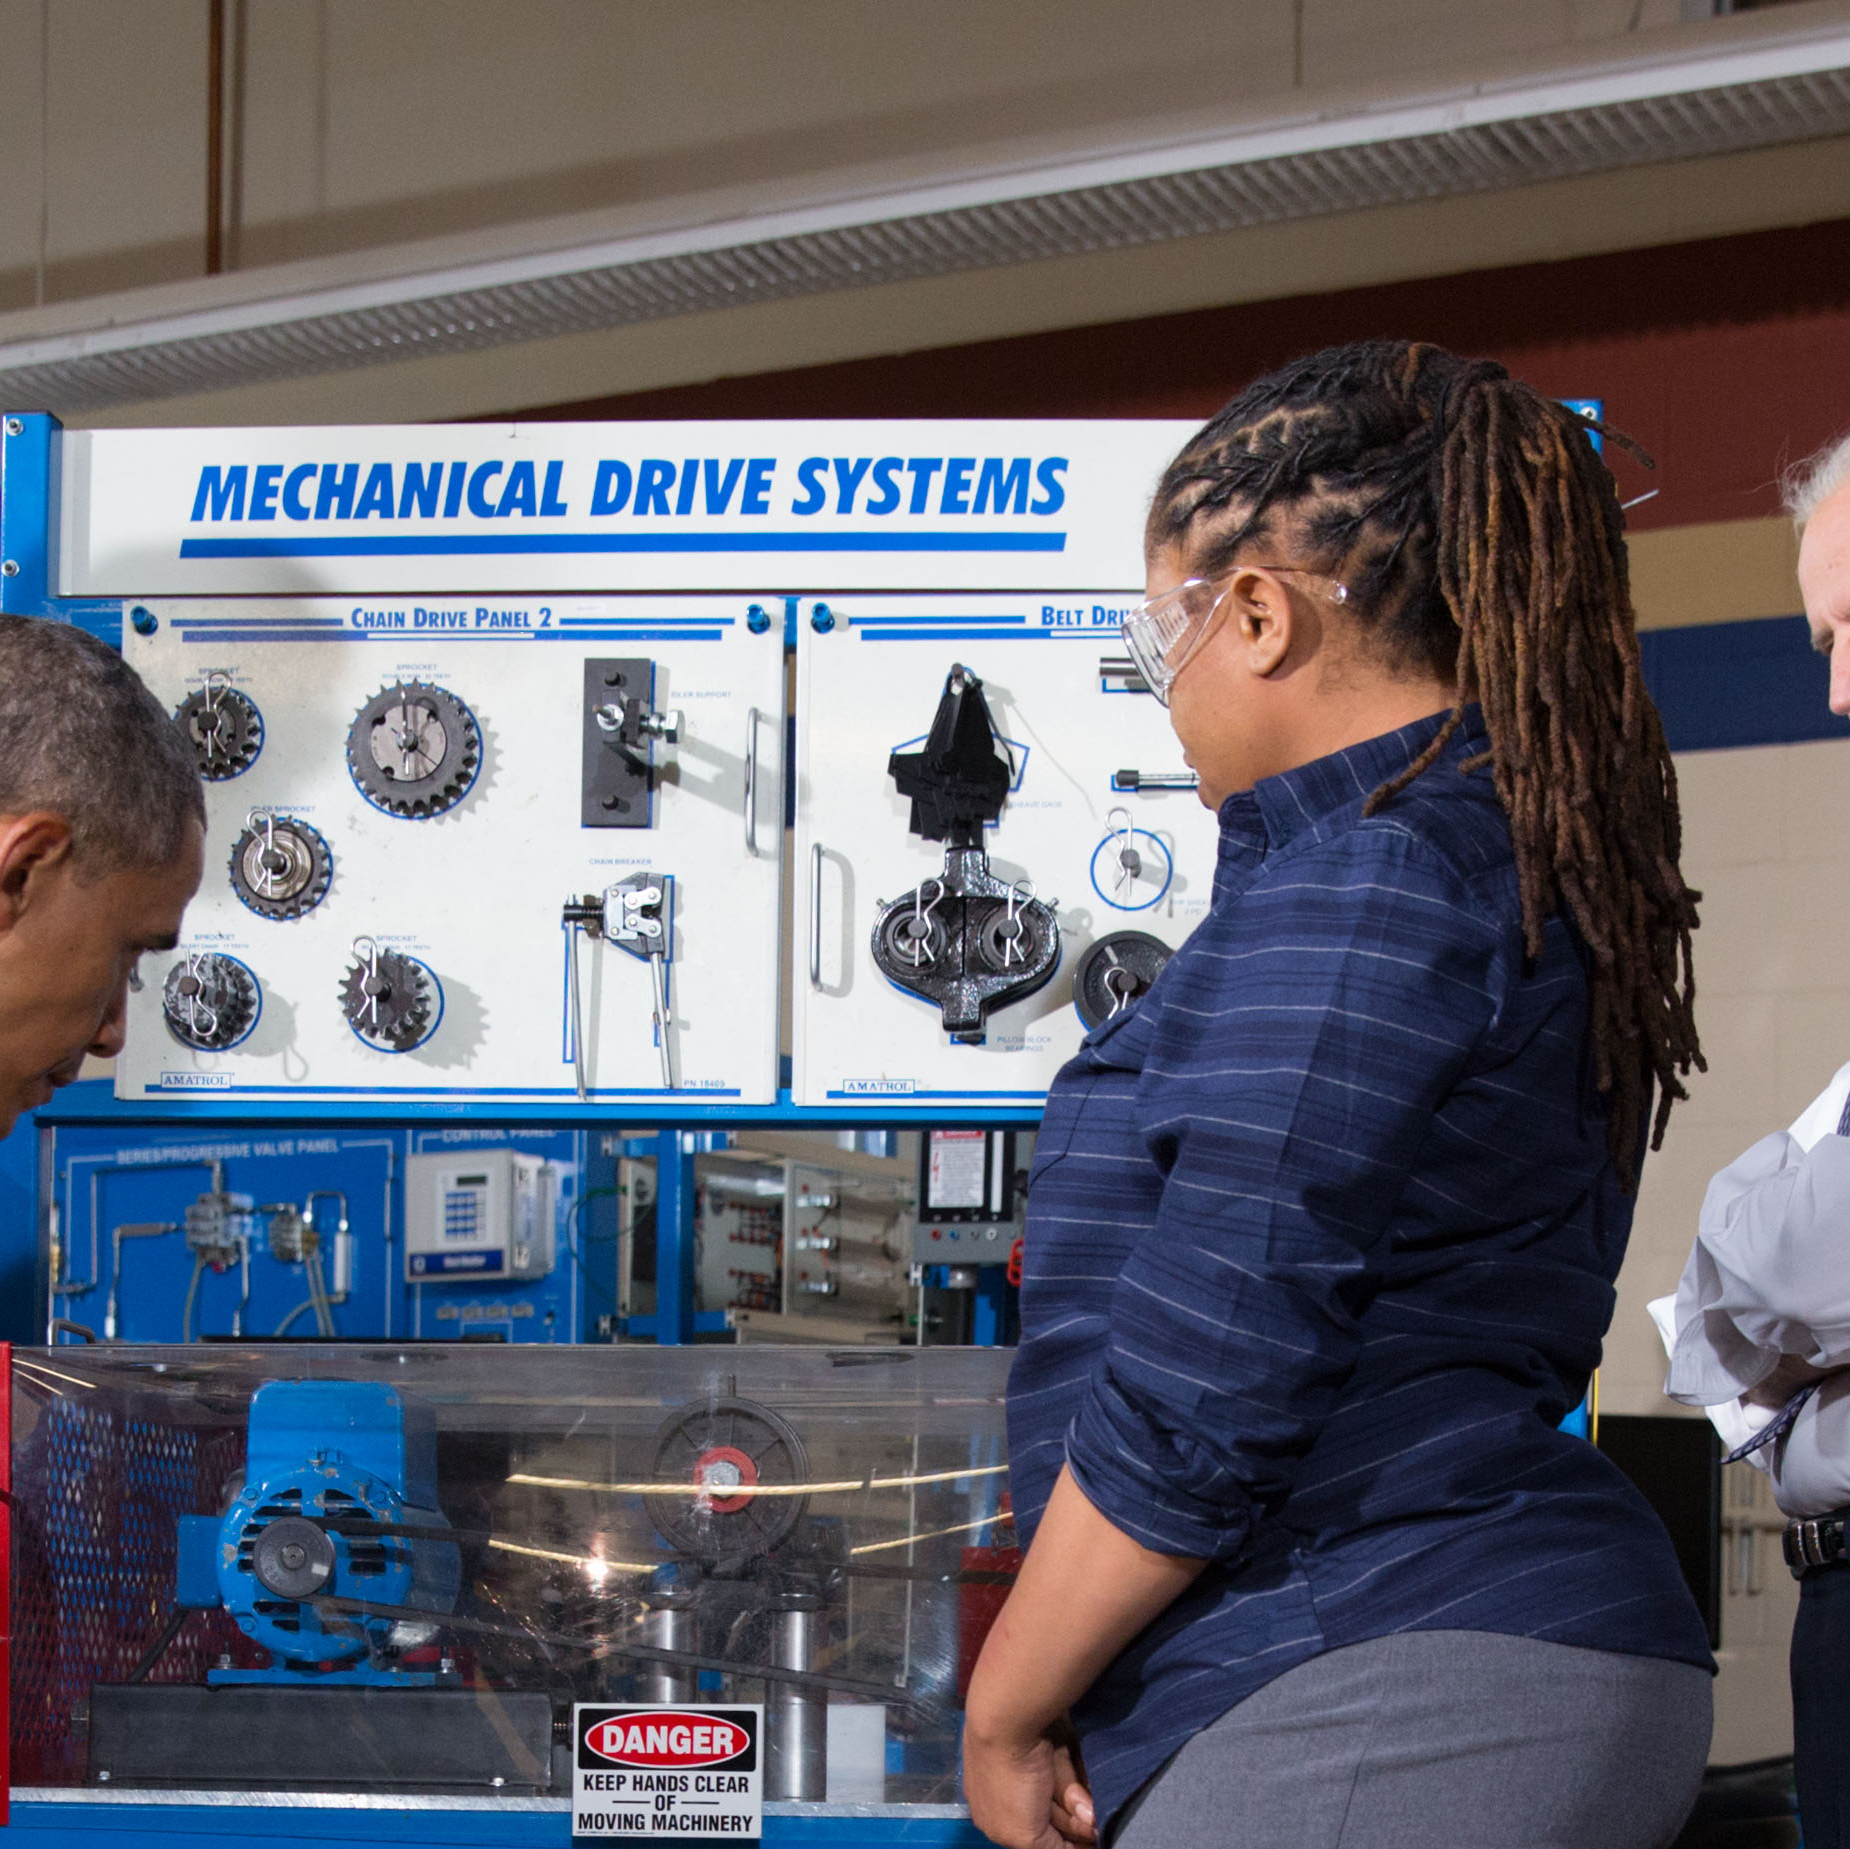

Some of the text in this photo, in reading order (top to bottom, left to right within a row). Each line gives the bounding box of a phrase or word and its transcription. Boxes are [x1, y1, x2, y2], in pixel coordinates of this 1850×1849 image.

[191, 456, 1069, 522] MECHANICAL DRIVE SYSTEMS
[351, 606, 552, 629] CHAIN DRIVE PANEL 2
[1042, 605, 1130, 628] BELT DRI
[396, 663, 438, 671] SPROCKET
[274, 805, 316, 813] SPROCKET
[589, 858, 652, 866] CHAIN BREAKER
[194, 933, 236, 941] SPROCKET
[376, 934, 417, 942] SPROCKET
[163, 1075, 228, 1086] AMATROL
[683, 1079, 697, 1089] PN
[847, 1081, 912, 1092] AMATROL
[253, 1141, 294, 1157] VALVE
[297, 1138, 340, 1153] PANEL
[603, 1725, 734, 1755] DANGER
[583, 1774, 749, 1793] KEEP HANDS CLEAR
[655, 1794, 676, 1811] OF
[578, 1812, 753, 1832] MOVING MACHINERY
